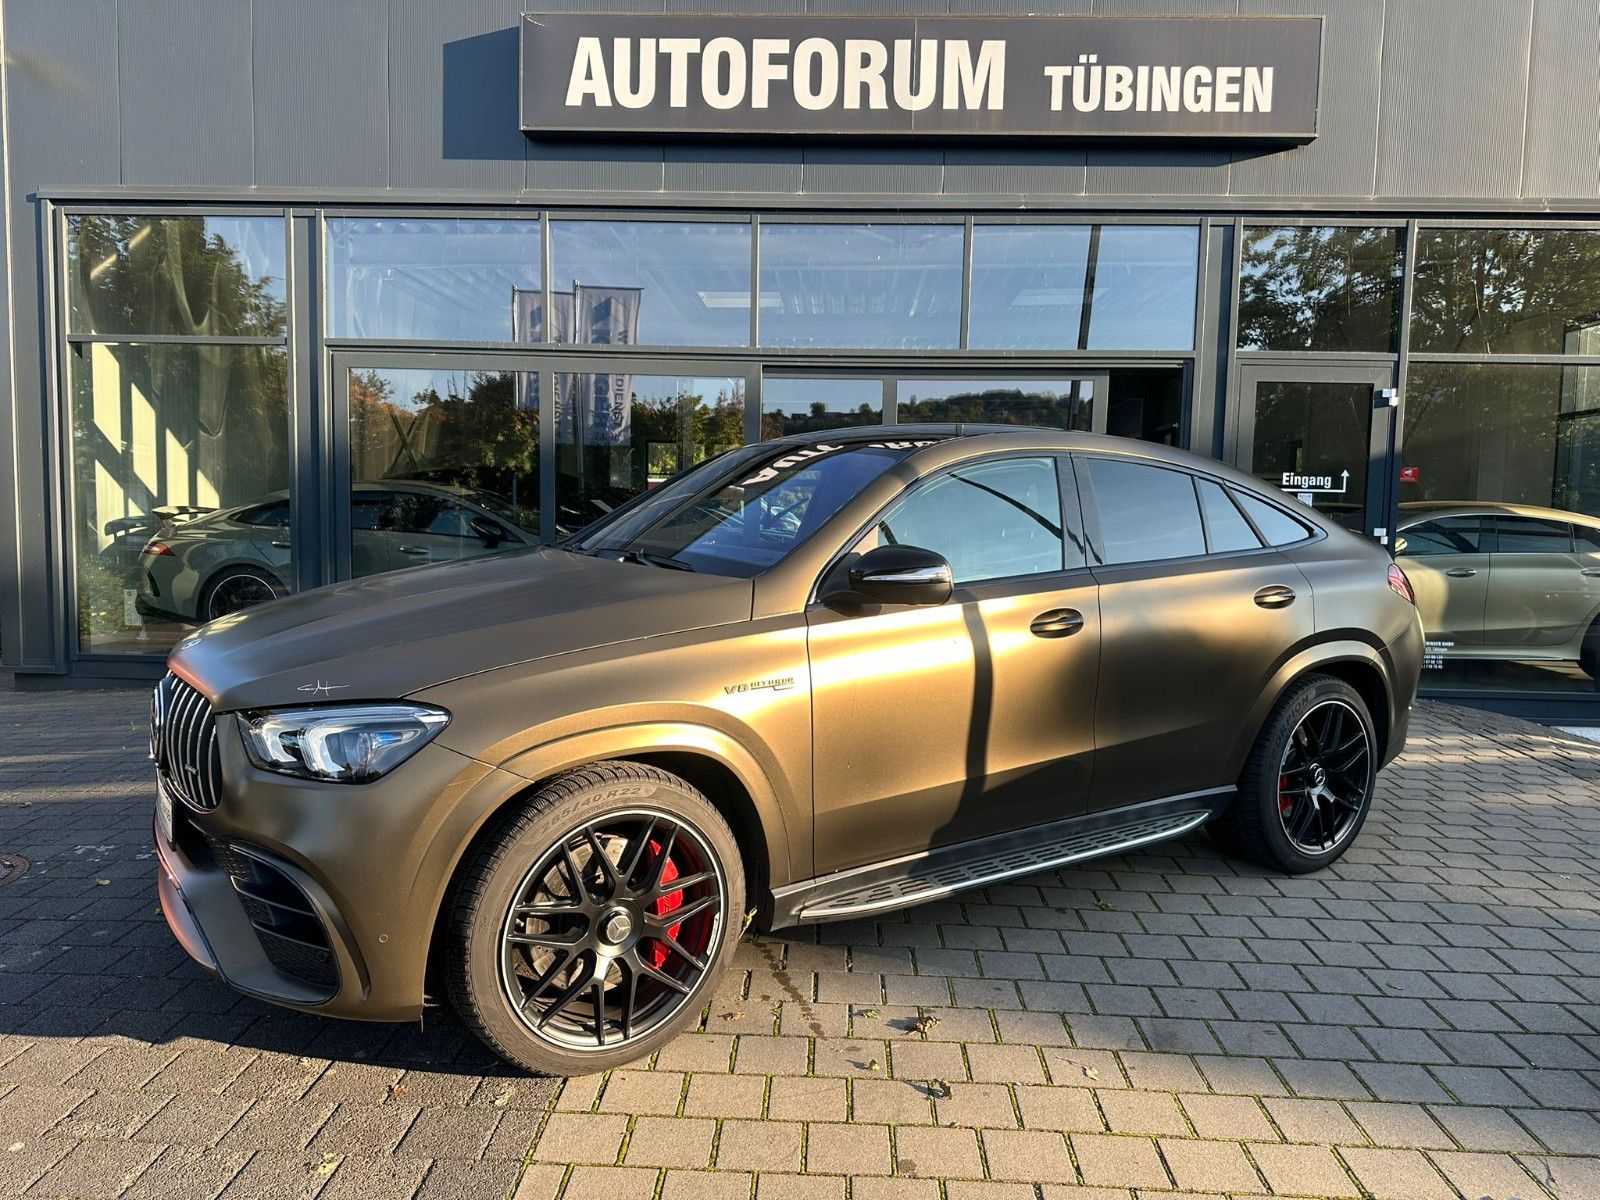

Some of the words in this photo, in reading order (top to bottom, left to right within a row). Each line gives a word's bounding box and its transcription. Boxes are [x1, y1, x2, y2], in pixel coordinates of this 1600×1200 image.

[564, 37, 1006, 111] AUTOFORUM
[1044, 55, 1274, 114] TÜBINGEN
[1282, 472, 1332, 488] Eingang
[542, 794, 603, 835] 285/40
[606, 787, 642, 799] R22
